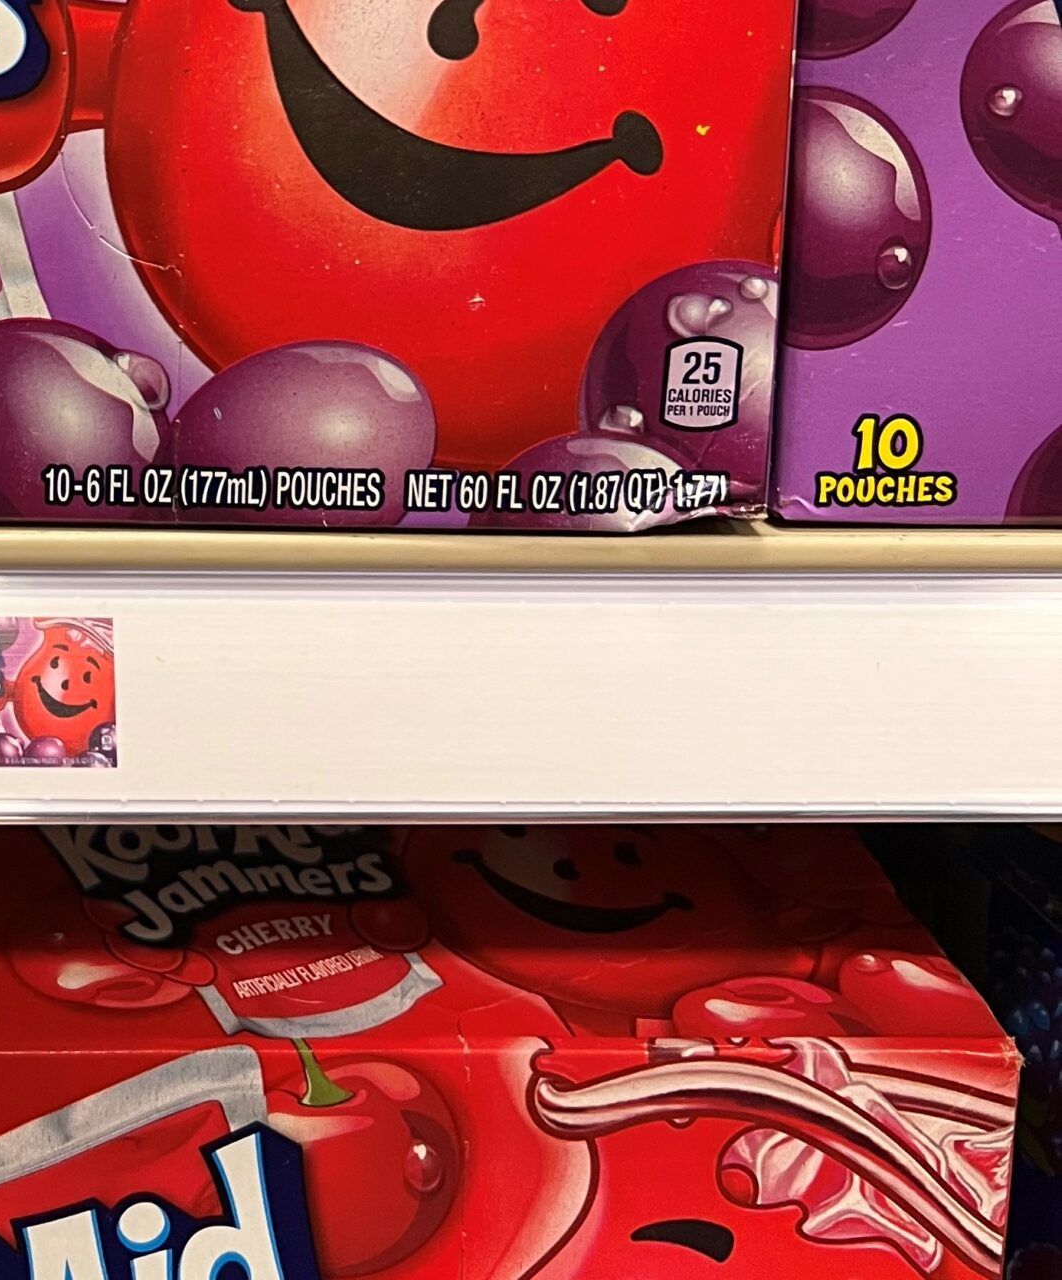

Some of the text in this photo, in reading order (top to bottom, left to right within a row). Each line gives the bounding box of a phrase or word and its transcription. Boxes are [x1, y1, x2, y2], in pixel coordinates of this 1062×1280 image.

[682, 352, 722, 385] 25
[667, 405, 730, 416] PER 1 POUCH
[668, 389, 732, 403] CALORIES
[857, 418, 919, 470] 10
[110, 469, 135, 503] FL
[144, 469, 172, 504] OZ
[180, 469, 267, 507] (177mL)
[277, 471, 381, 507] POUCHES
[407, 474, 452, 509] NET
[460, 474, 488, 509] 60
[497, 475, 521, 509] FL
[532, 475, 561, 509] OZ
[569, 474, 620, 511] (1.87
[628, 472, 666, 510] QT)
[819, 475, 954, 503] POUCHES
[124, 853, 392, 941] Jammers
[216, 914, 333, 955] CHERRY
[233, 969, 302, 999] ARTIFICIALLY
[297, 955, 353, 982] FLAVORED
